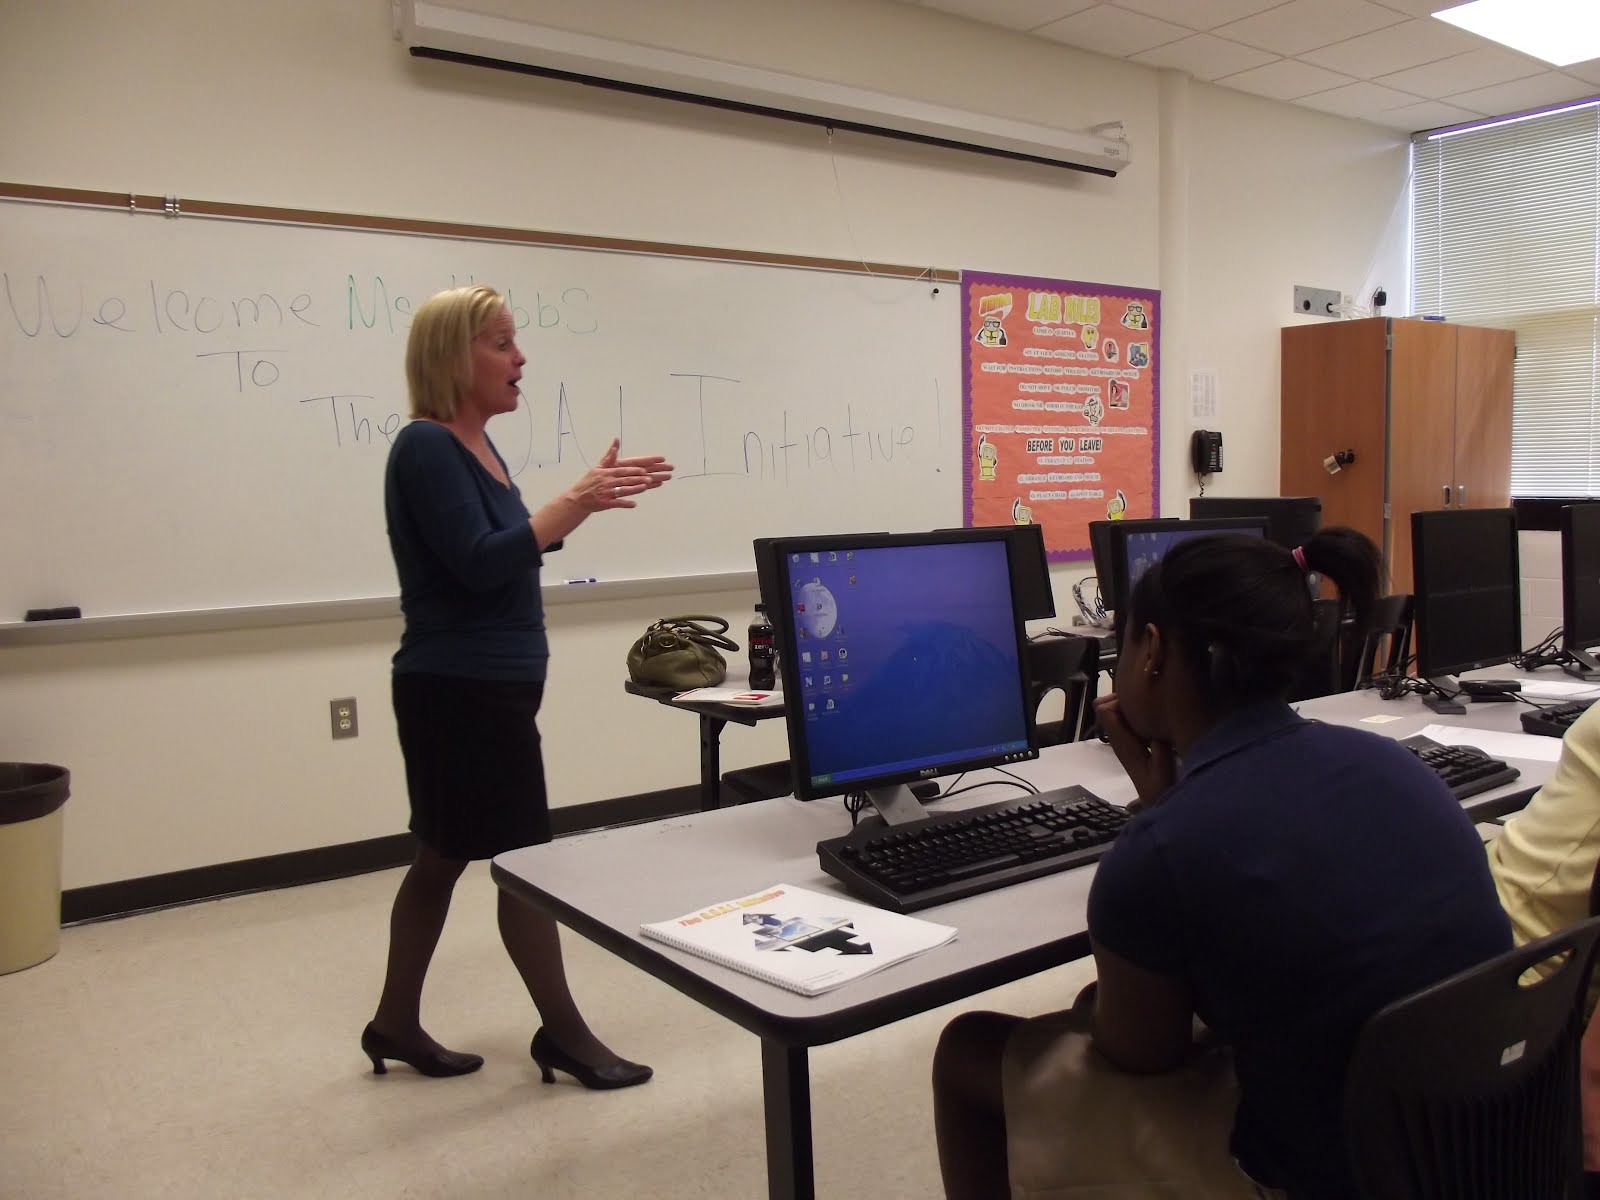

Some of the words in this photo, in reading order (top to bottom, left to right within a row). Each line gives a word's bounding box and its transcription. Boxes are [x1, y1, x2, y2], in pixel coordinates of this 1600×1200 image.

[3, 272, 320, 338] Welcome
[1028, 293, 1060, 321] LAB
[1065, 297, 1099, 324] RULES
[1027, 440, 1053, 452] BEFORE
[1060, 440, 1074, 452] YOU
[1080, 440, 1102, 452] LEAVE!
